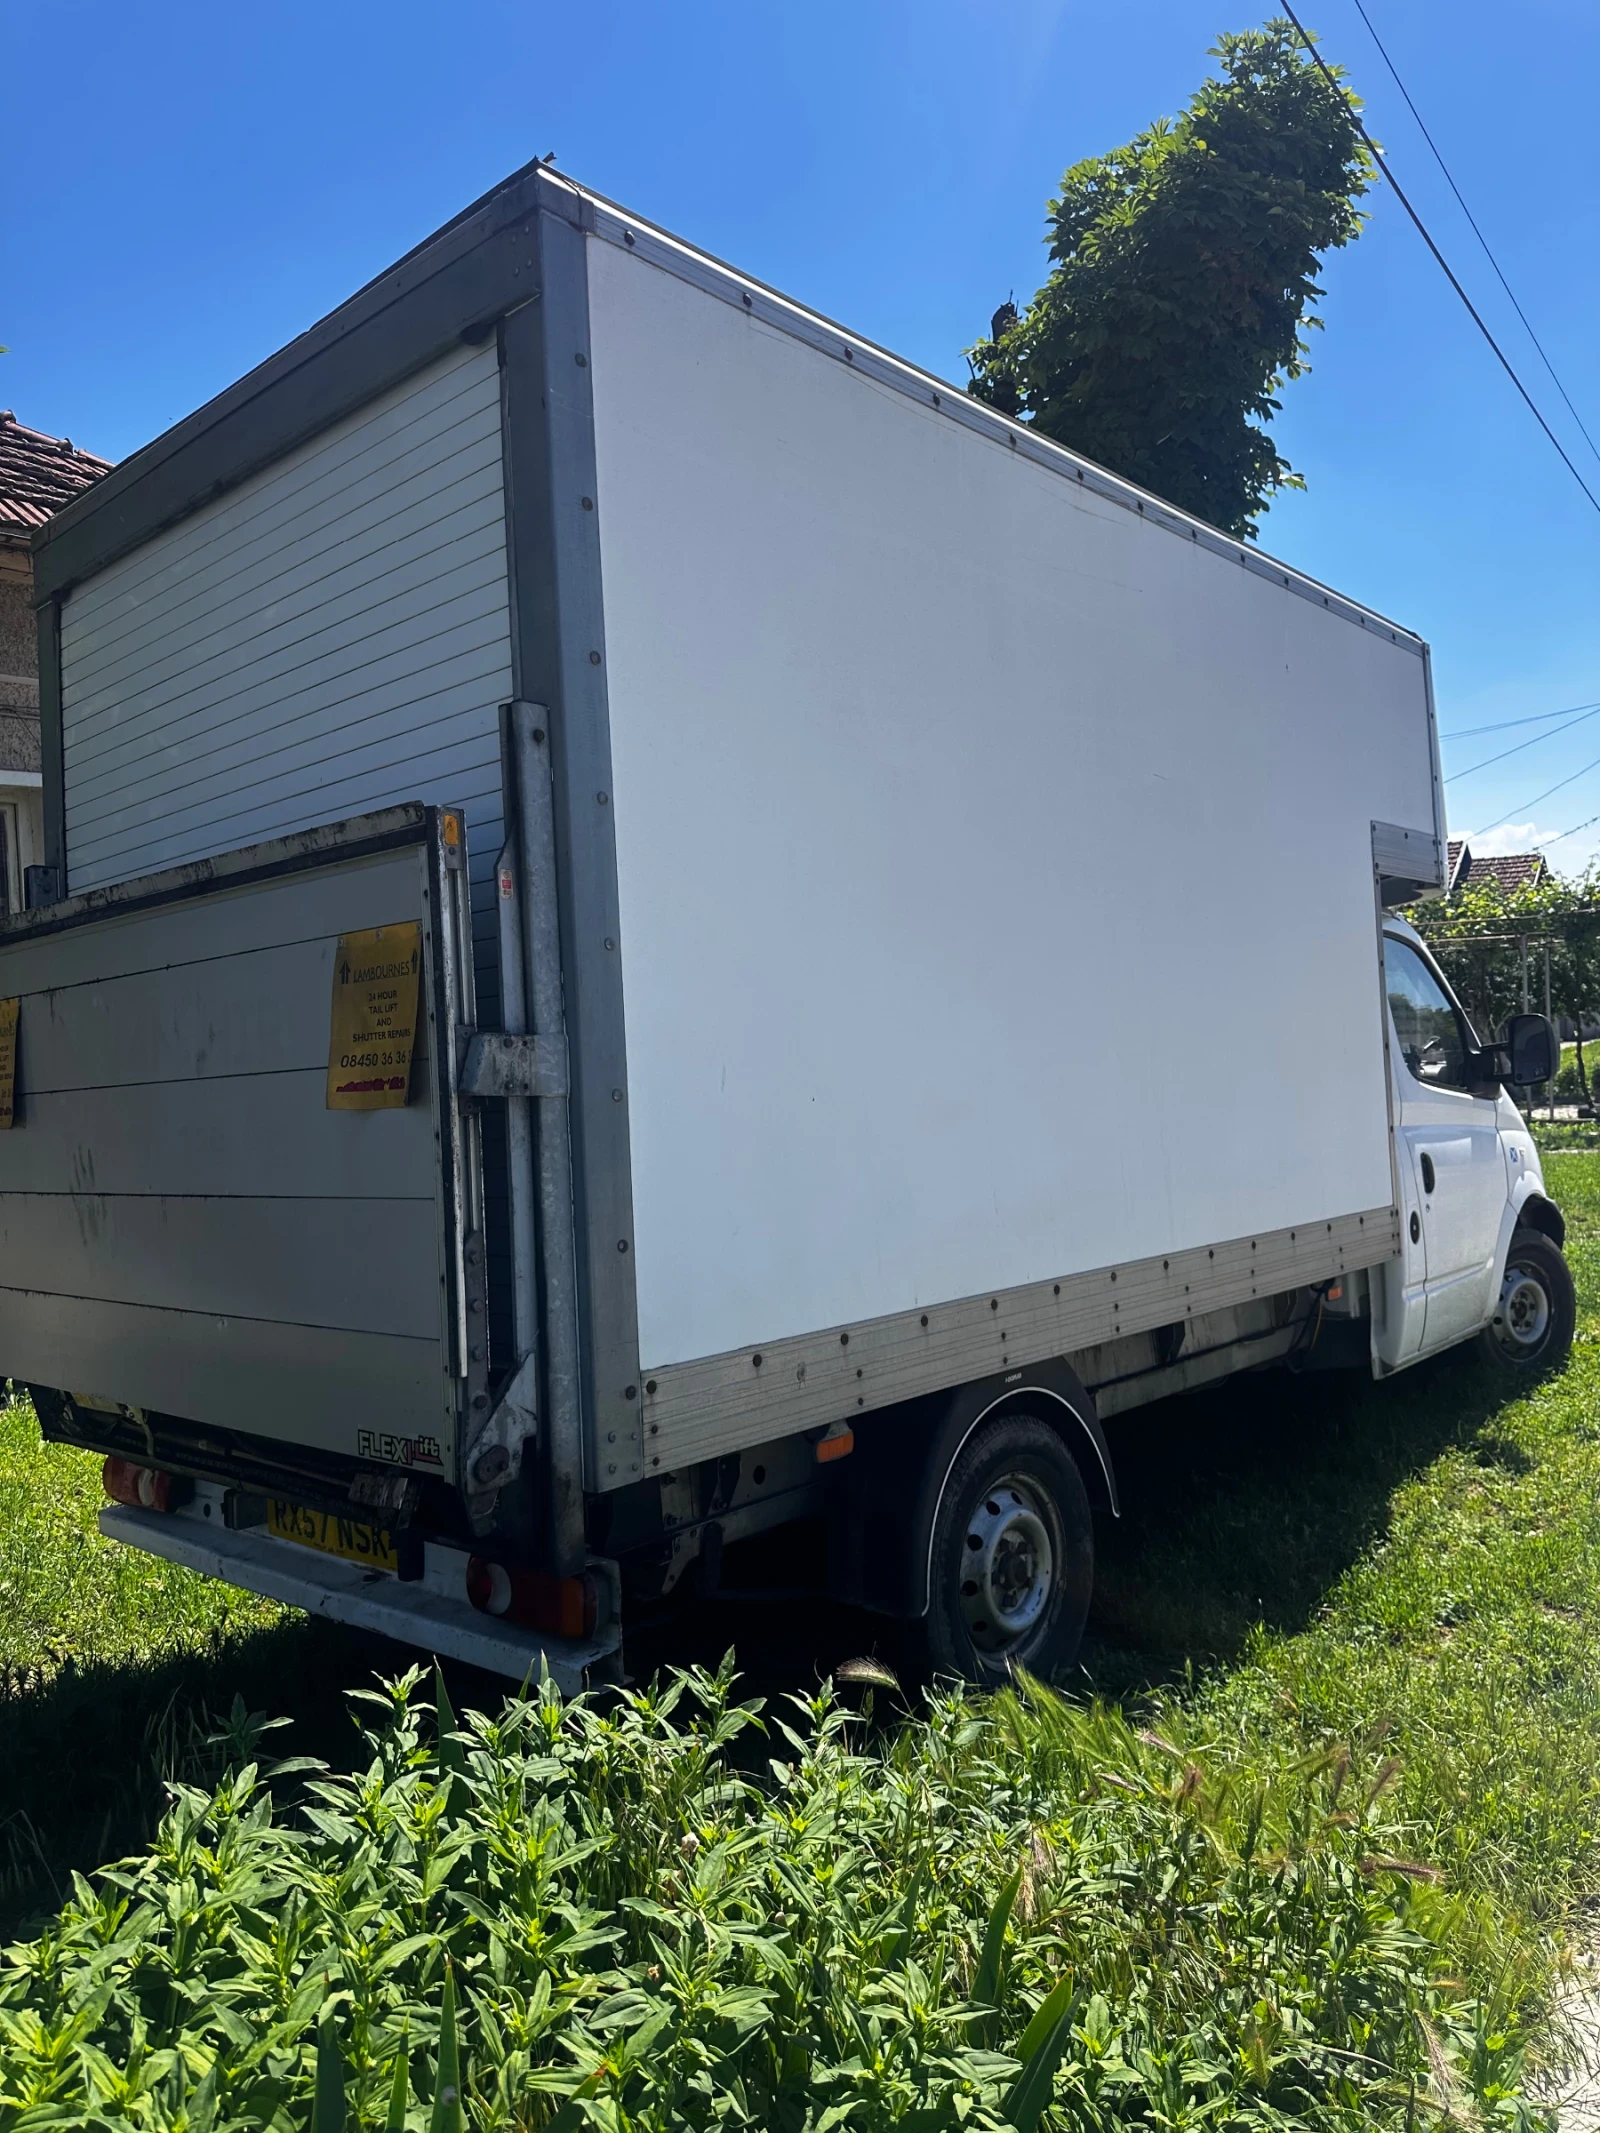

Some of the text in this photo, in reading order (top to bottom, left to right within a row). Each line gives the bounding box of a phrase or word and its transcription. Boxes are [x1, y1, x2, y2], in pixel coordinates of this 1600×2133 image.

[353, 960, 410, 983] LAMBOURNES
[368, 989, 398, 1002] 24 HOUR
[368, 1002, 398, 1015] TAIL LIFT
[376, 1017, 392, 1027] AND
[352, 1027, 411, 1042] SHUTTER REPAIRS
[340, 1053, 378, 1068] 08450
[381, 1051, 393, 1067] 36
[396, 1050, 406, 1065] 36
